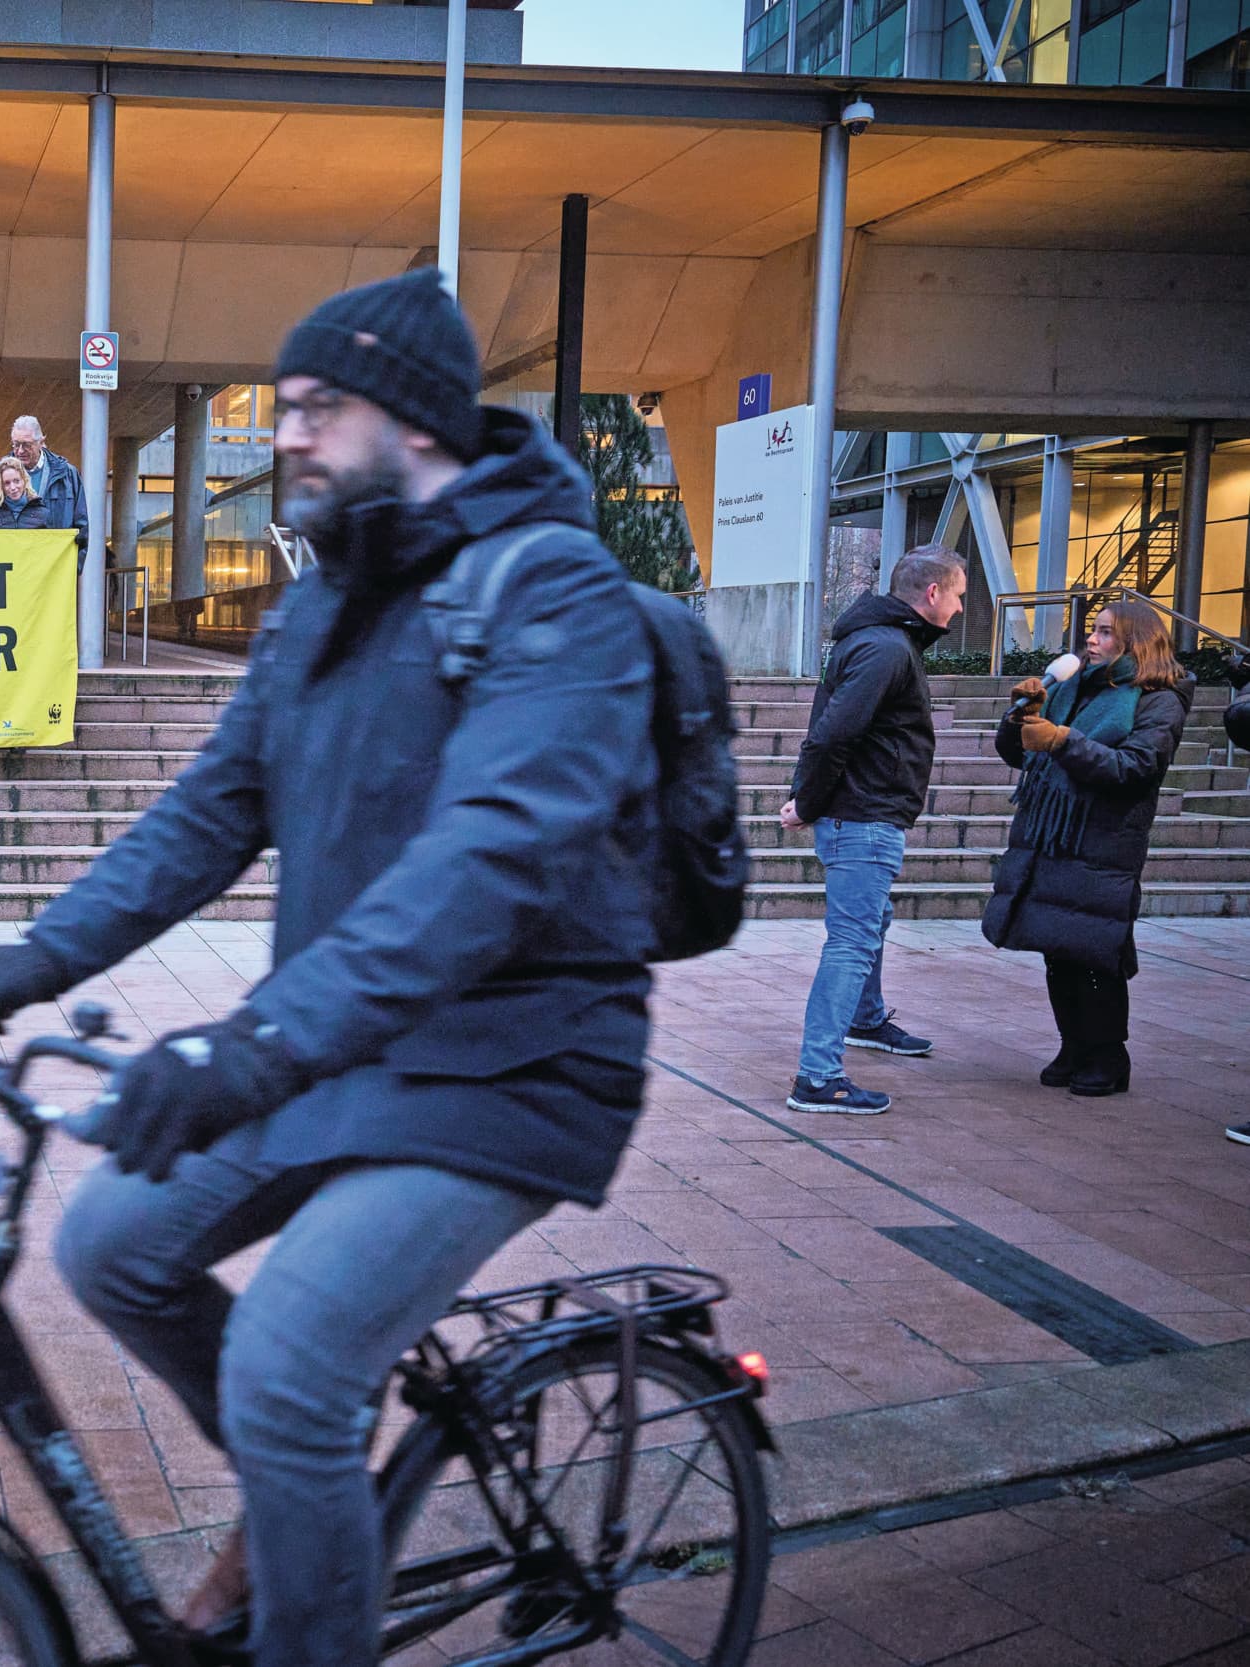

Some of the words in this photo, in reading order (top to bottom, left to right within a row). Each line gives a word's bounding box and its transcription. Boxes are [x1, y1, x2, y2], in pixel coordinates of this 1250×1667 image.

[743, 388, 756, 406] 60
[718, 497, 733, 507] Paleis
[744, 492, 764, 503] Justitie
[717, 518, 730, 527] Prins
[731, 513, 756, 525] Clauslaan
[756, 511, 764, 521] 60
